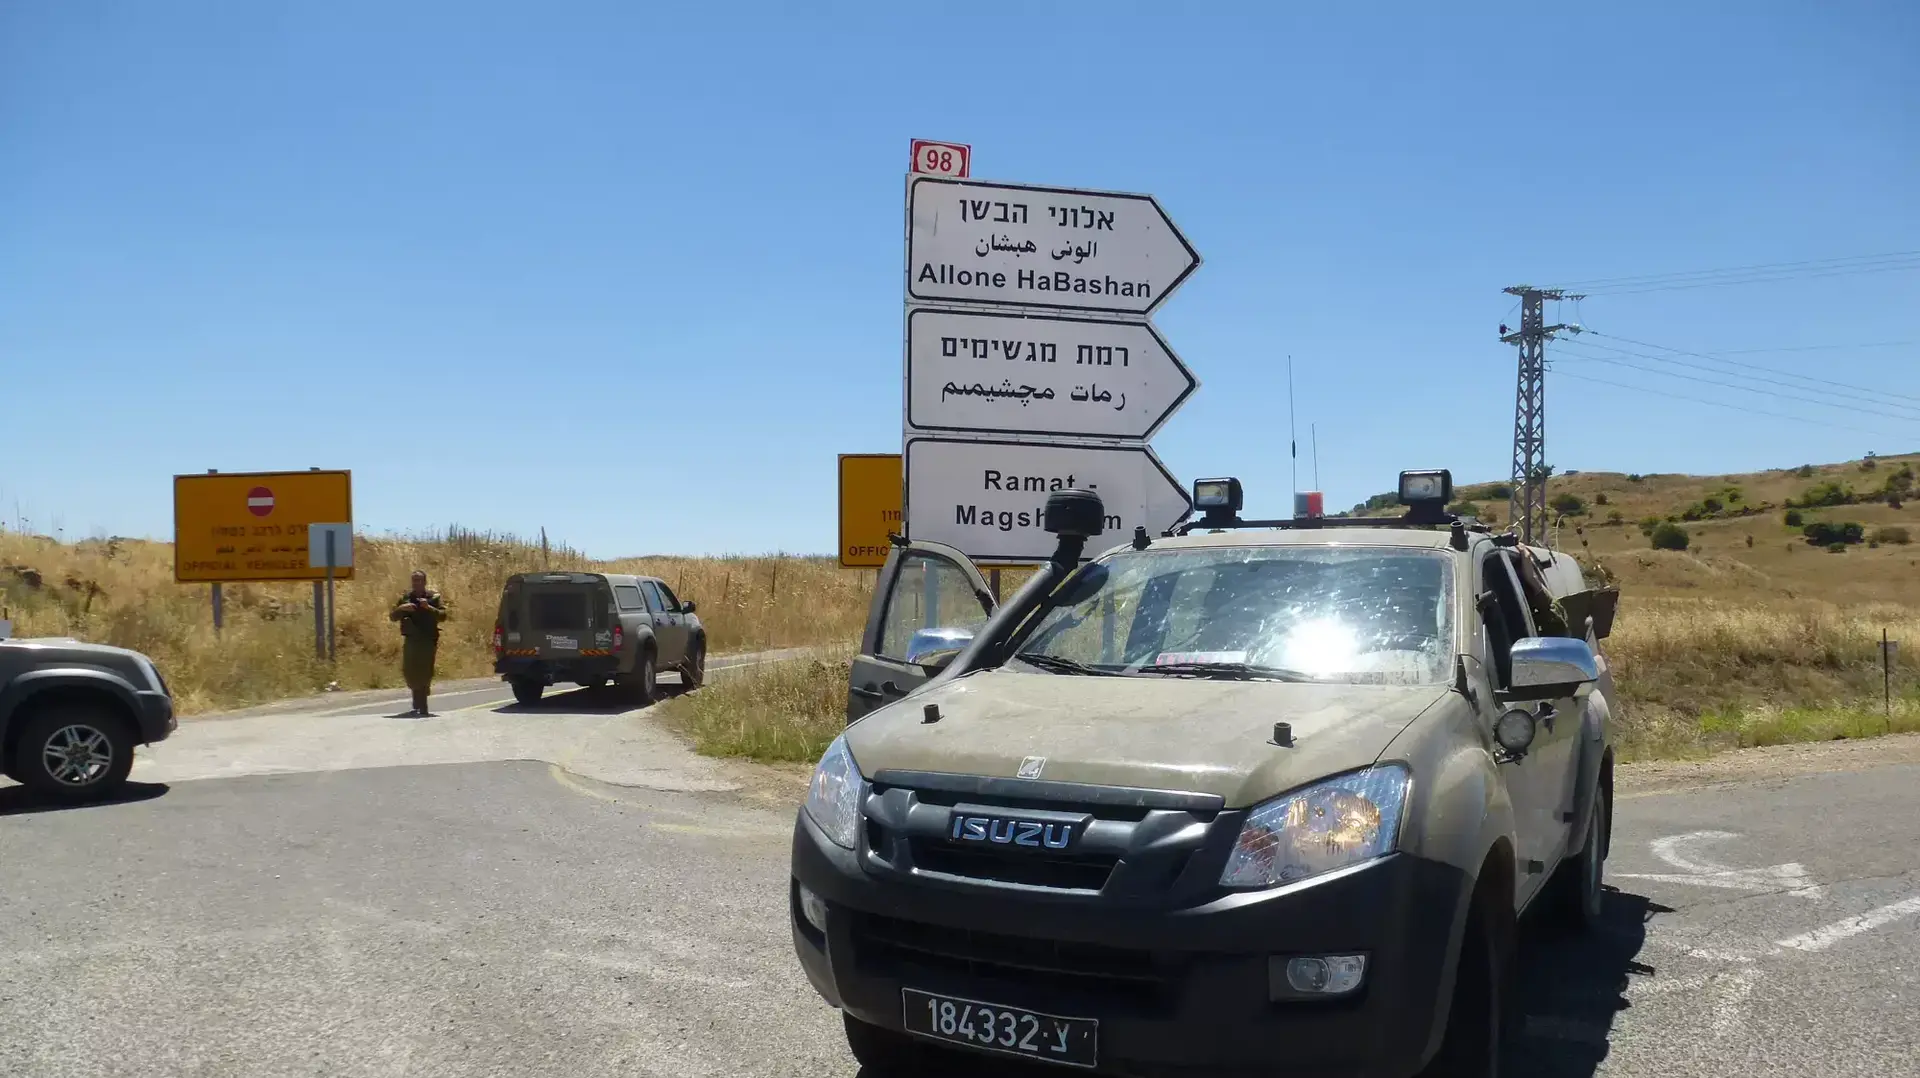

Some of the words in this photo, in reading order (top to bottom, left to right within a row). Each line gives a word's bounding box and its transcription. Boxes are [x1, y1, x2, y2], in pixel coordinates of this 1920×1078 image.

[926, 149, 952, 172] 98
[959, 199, 1028, 224] הבשן
[1048, 205, 1115, 231] אלוני
[975, 233, 1037, 258] هبشان
[918, 262, 1007, 288] Allone
[1017, 269, 1151, 298] HaBashan
[941, 336, 1058, 363] מגשימים
[1076, 344, 1130, 367] רמת
[1070, 383, 1126, 411] رمات
[984, 469, 1076, 492] Ramat
[956, 504, 1122, 531] Magshm
[952, 816, 1071, 849] ISUZU
[928, 998, 1040, 1052] 184332
